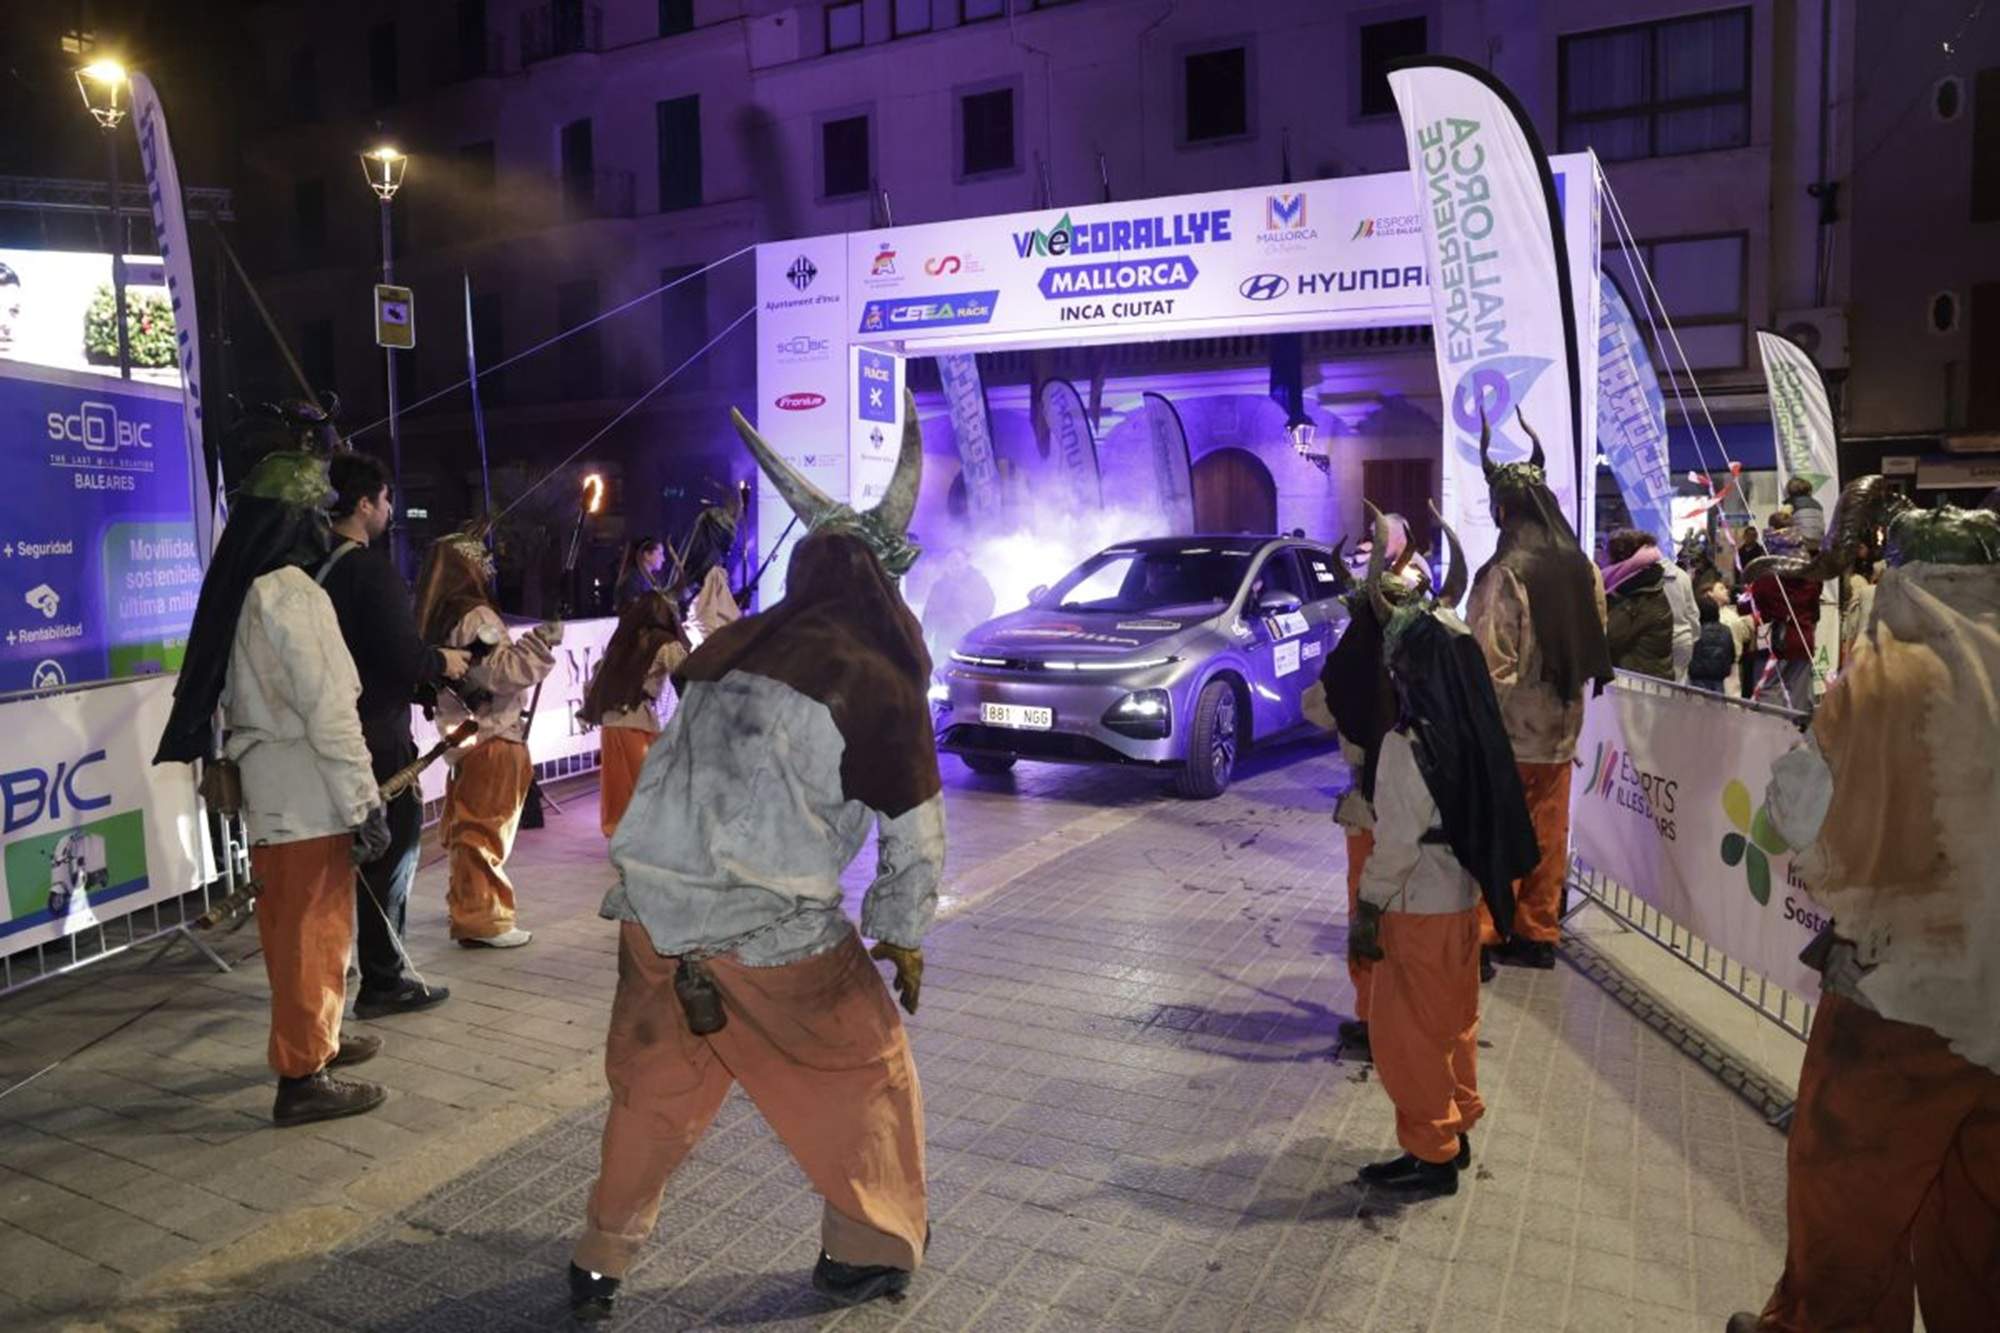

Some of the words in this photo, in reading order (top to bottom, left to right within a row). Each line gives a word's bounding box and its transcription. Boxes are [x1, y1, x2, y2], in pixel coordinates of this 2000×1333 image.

[1376, 214, 1423, 229] ESPORT
[1256, 229, 1319, 243] MALLORCA
[1051, 263, 1188, 293] MALLORCA
[1060, 304, 1106, 321] INCA
[1111, 299, 1175, 318] CIUTAT
[48, 401, 153, 451] SCOBIC
[74, 473, 135, 491] BALEARES
[17, 541, 73, 559] Seguridad
[19, 624, 83, 644] Rentabilidad
[989, 706, 1012, 721] 881
[1024, 709, 1049, 725] NGG
